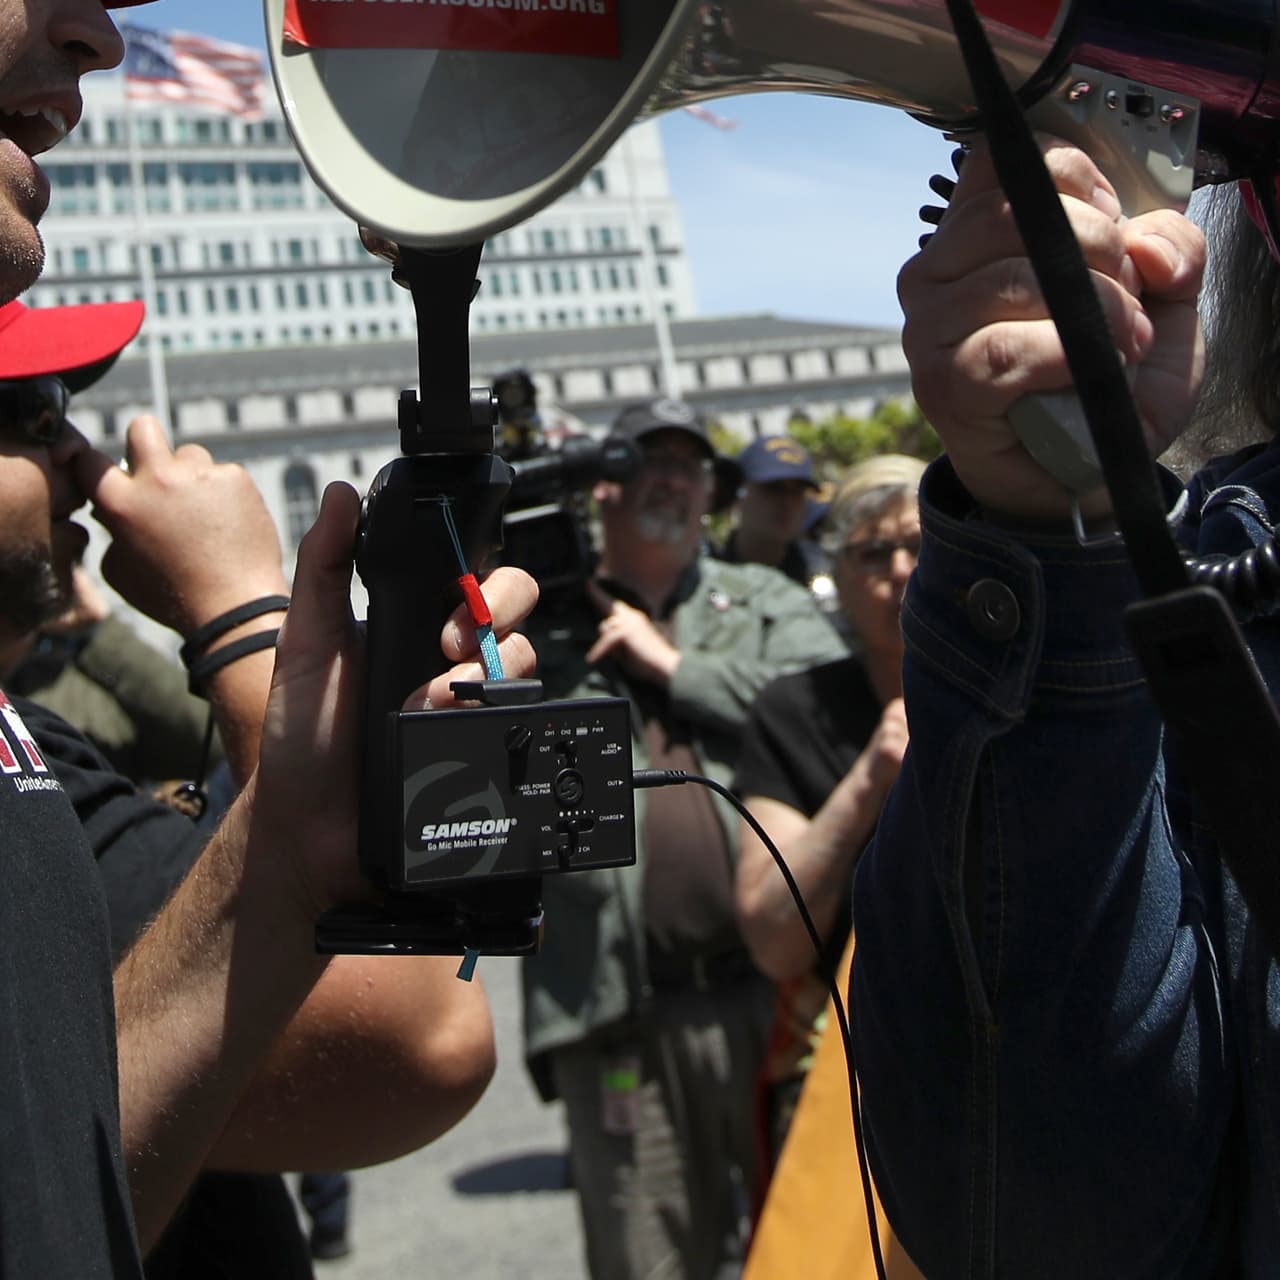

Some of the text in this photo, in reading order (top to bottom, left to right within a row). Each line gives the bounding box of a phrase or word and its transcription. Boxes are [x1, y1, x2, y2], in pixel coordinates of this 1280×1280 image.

[599, 814, 619, 822] CHARGE
[427, 837, 508, 851] Go Mic Mobile Receiver
